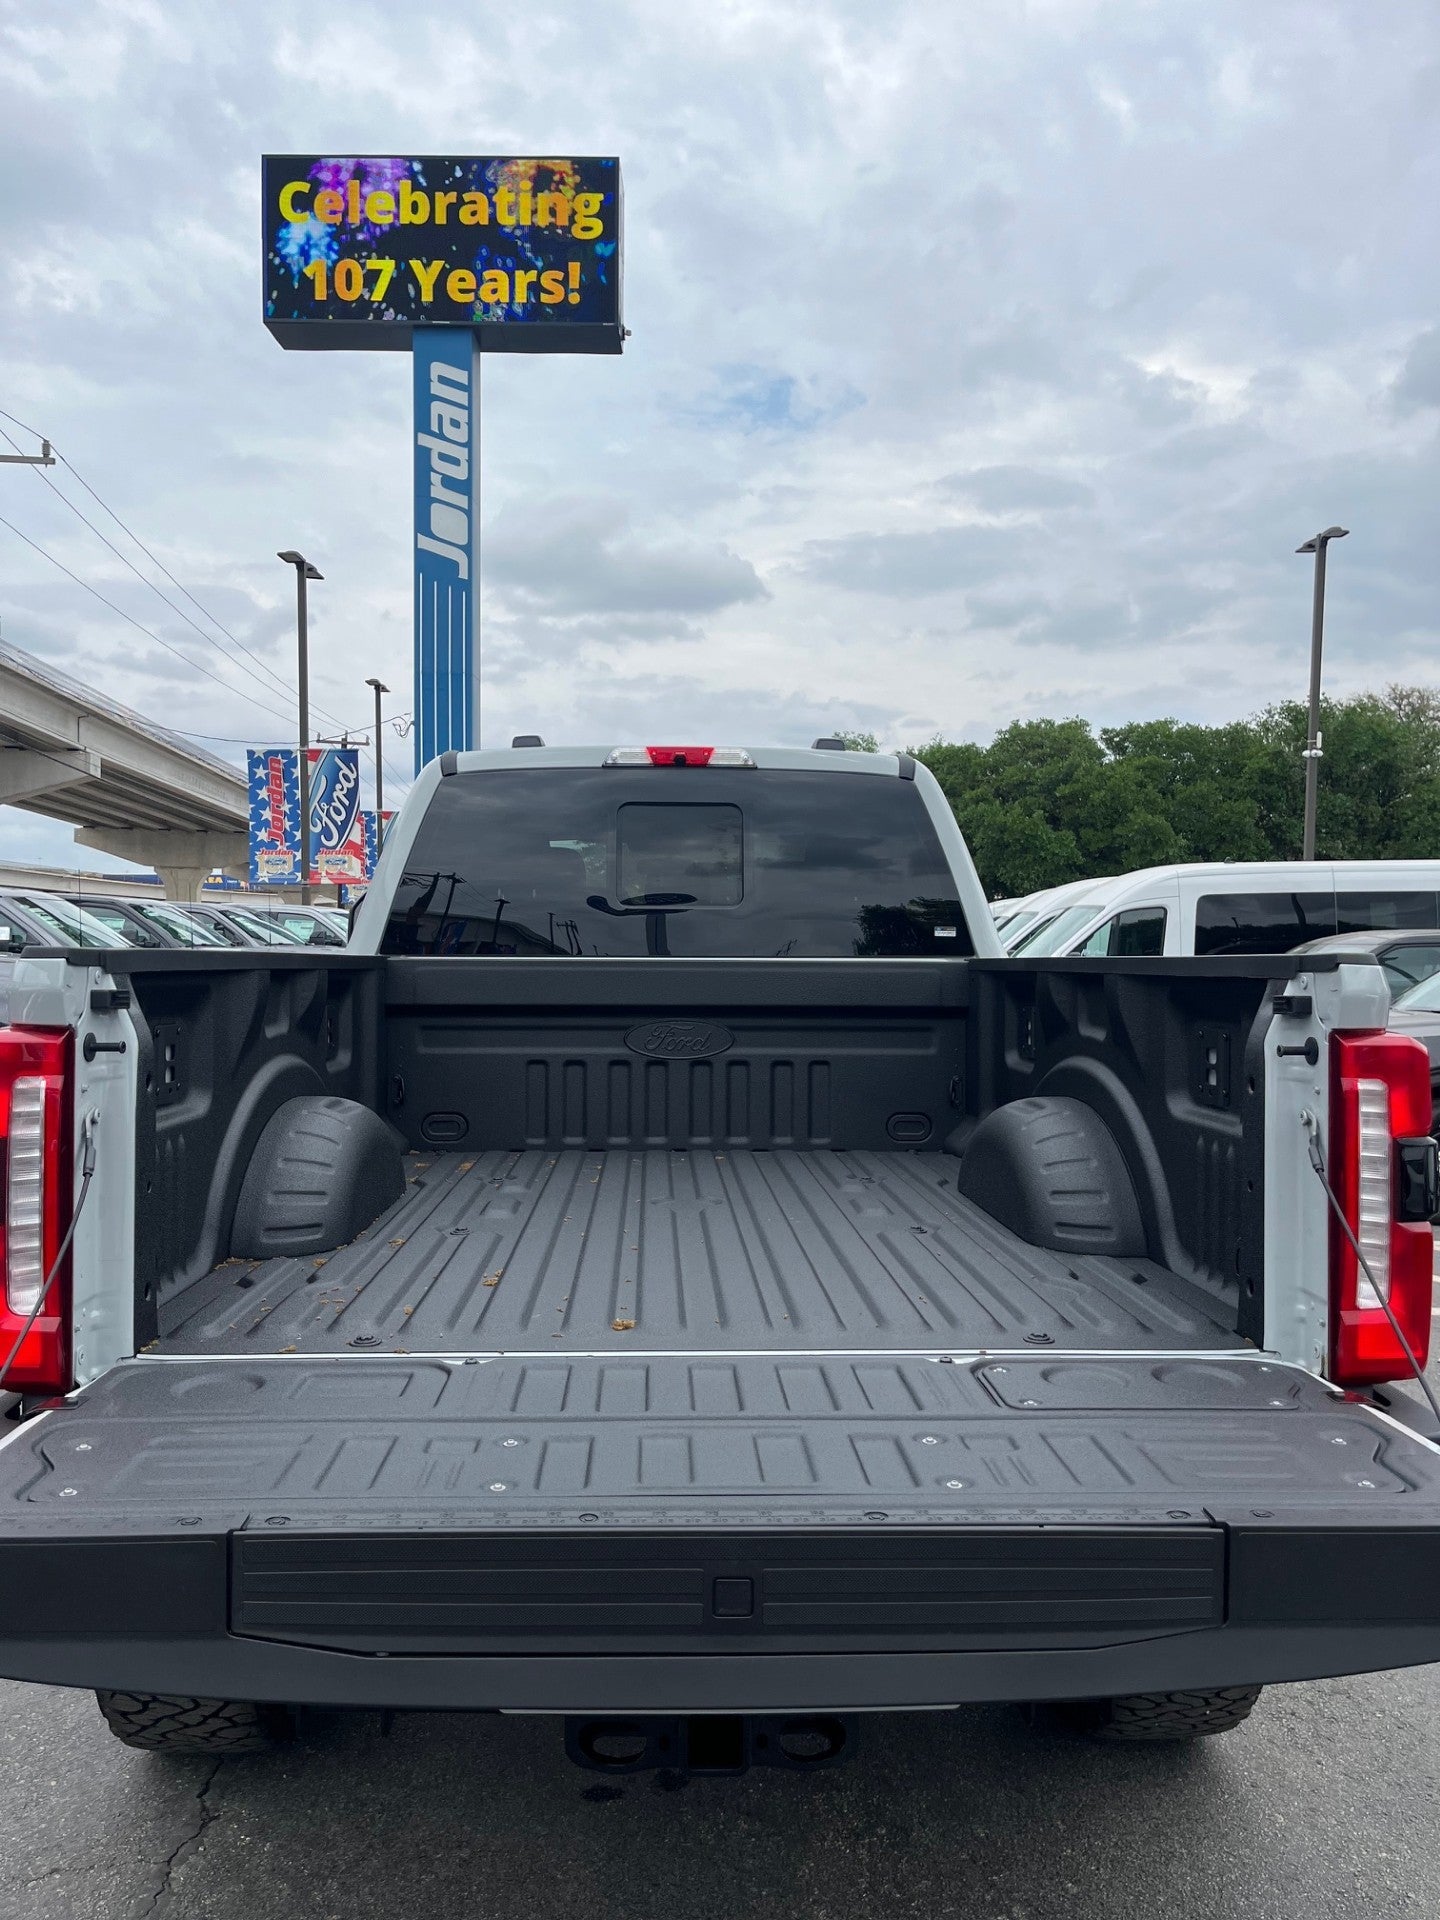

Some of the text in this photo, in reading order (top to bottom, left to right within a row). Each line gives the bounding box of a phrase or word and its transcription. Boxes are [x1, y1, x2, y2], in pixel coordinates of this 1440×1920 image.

[278, 179, 605, 240] Celebrating
[303, 259, 582, 304] 107 Years!
[417, 360, 469, 581] Jordan
[266, 756, 285, 847] Jordan
[310, 755, 358, 847] Ford
[259, 848, 294, 856] Jordan
[320, 848, 354, 856] Jordan
[645, 1025, 712, 1051] Ford
